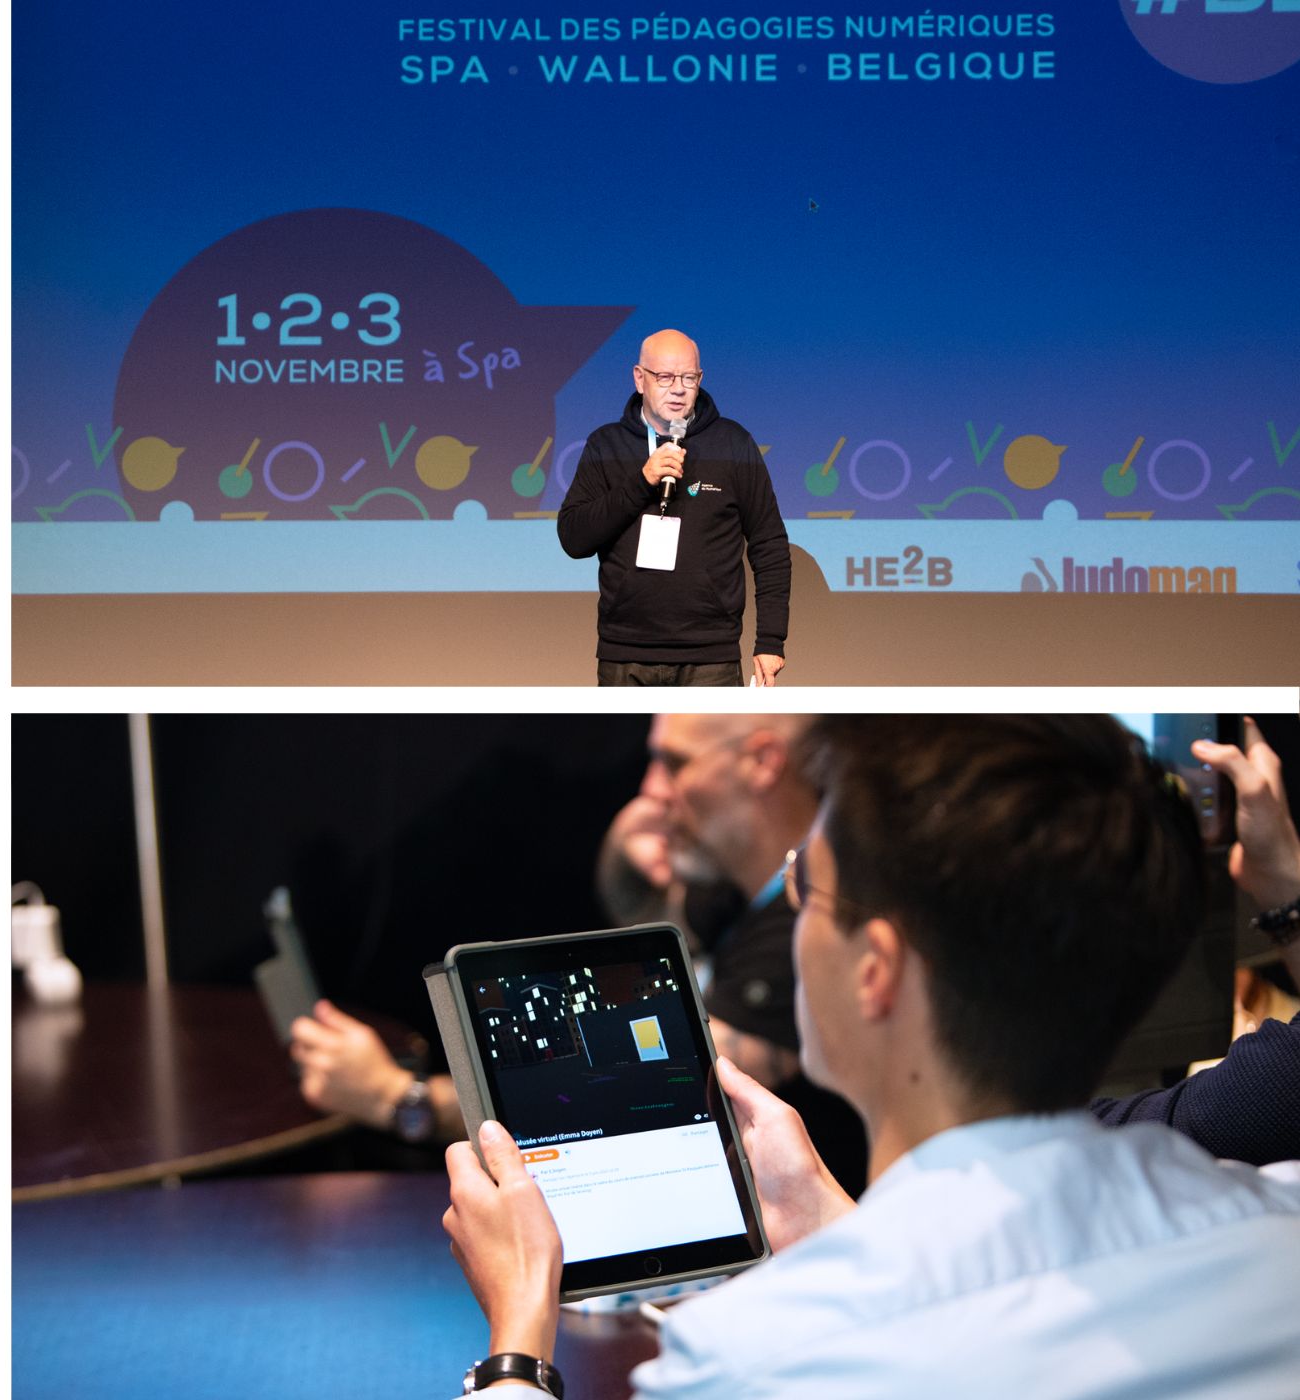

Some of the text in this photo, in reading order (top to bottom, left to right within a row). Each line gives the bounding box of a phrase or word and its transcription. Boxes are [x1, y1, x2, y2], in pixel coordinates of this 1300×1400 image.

[399, 9, 1055, 42] FESTIVAL DES PÉDAGOGIES NUMÉRIQUES
[401, 51, 1055, 84] SPA WALLONIE BELGIQUE
[214, 341, 522, 390] NOVEMBRE à Spa
[516, 1127, 604, 1146] Musée virtuel (Emma Doyen)
